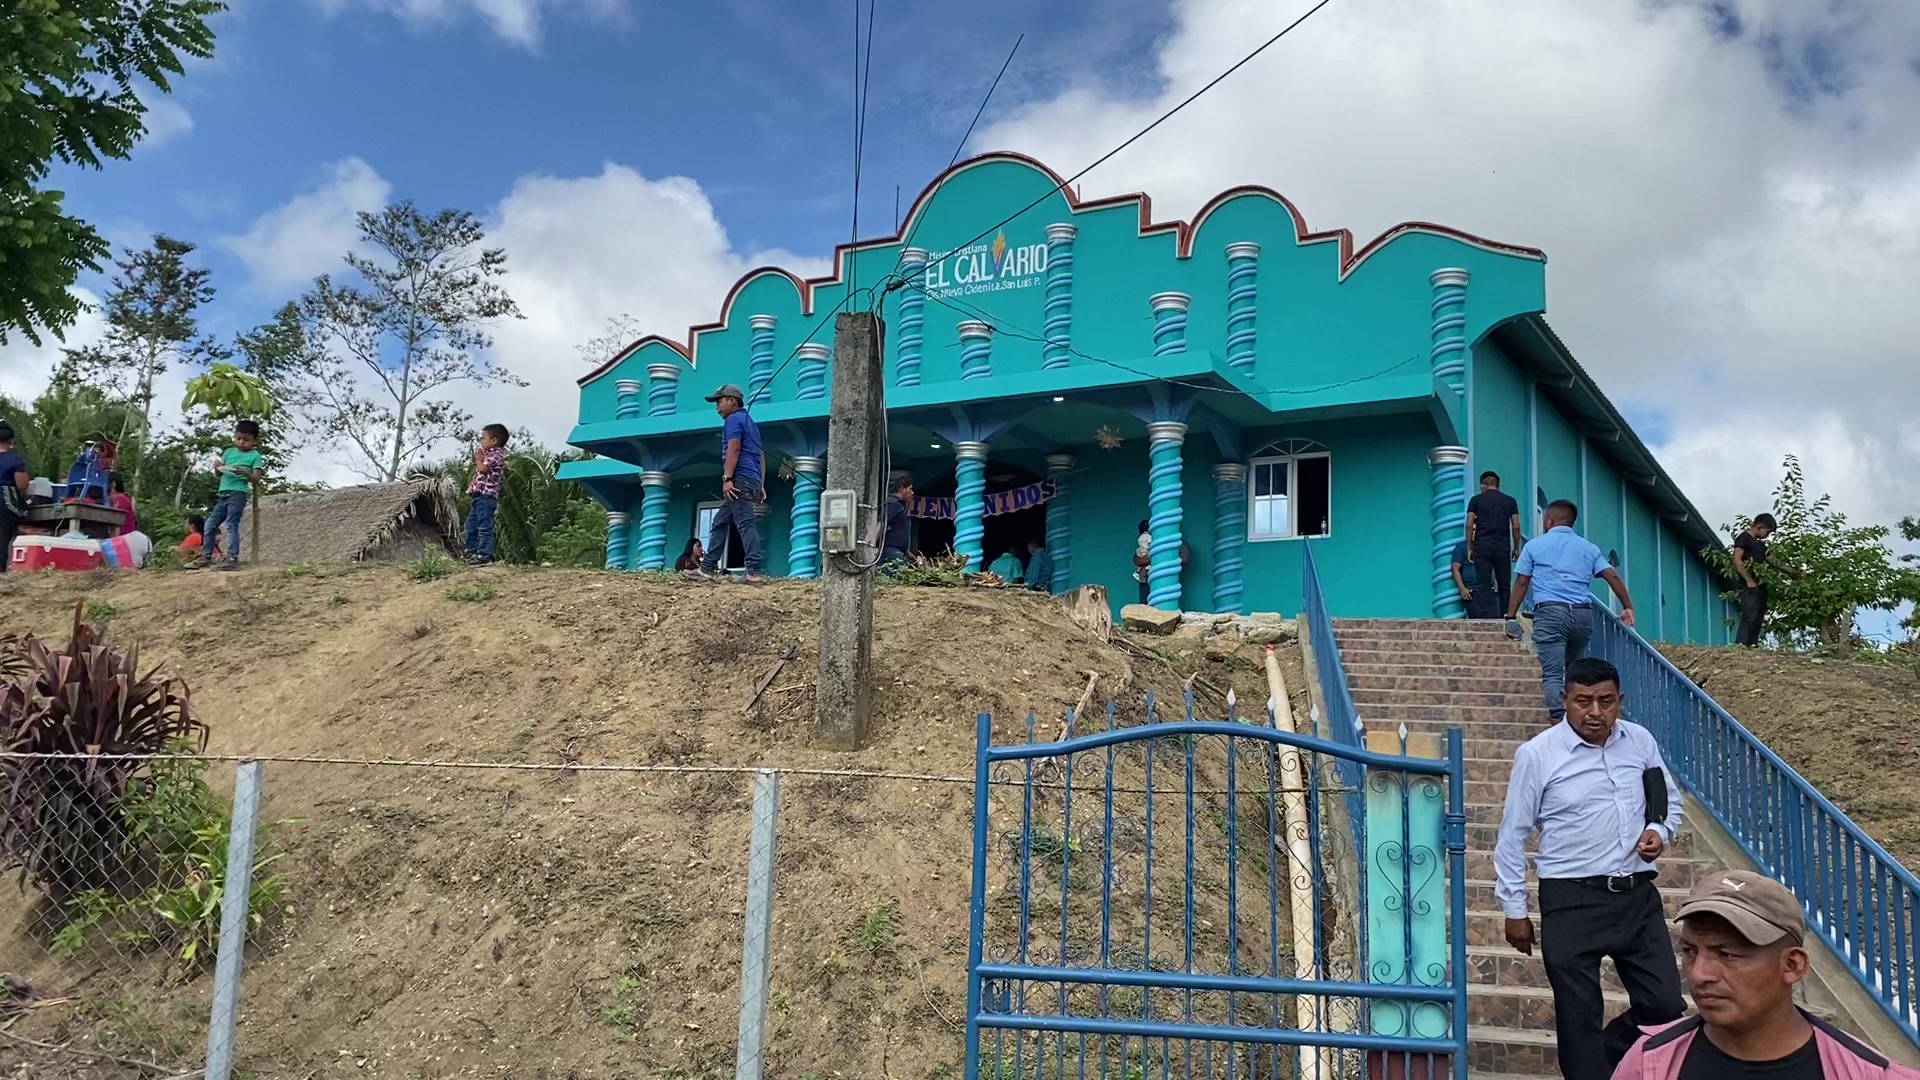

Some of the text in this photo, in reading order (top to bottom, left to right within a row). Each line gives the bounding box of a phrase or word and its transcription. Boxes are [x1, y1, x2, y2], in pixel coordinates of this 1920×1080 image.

[925, 243, 1048, 288] EL CALVARIO
[910, 479, 1054, 517] IENNIDOS
